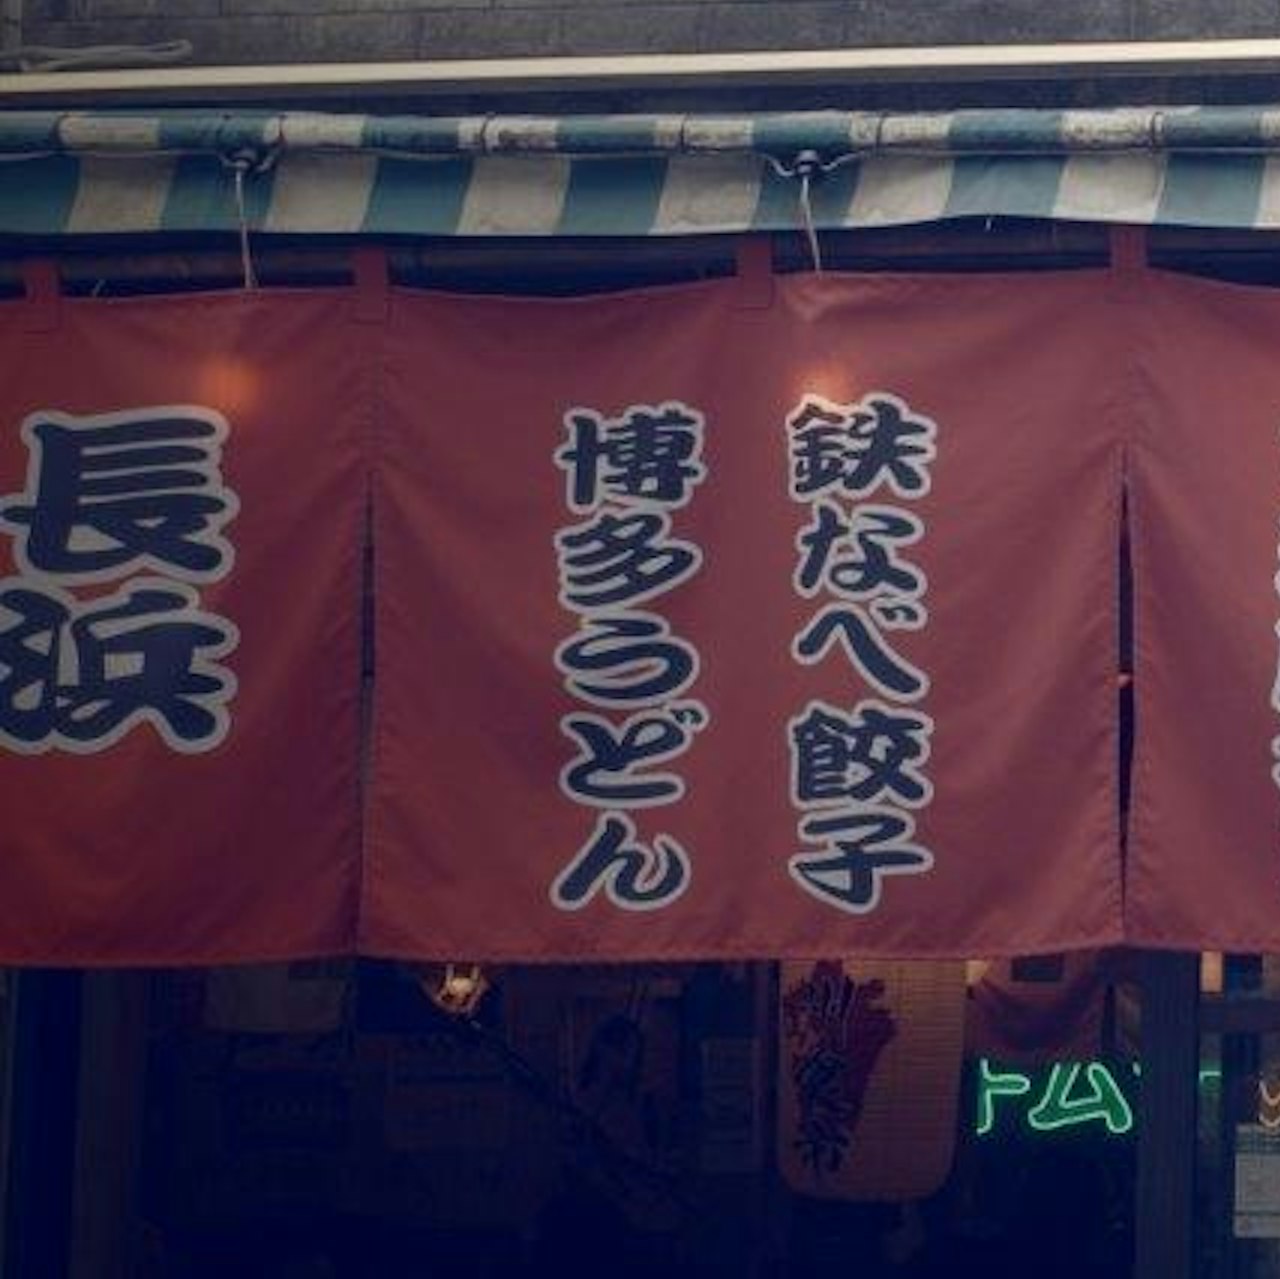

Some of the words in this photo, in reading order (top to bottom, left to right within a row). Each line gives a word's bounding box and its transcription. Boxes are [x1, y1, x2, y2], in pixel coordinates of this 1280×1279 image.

[0, 406, 240, 753] 長浜
[551, 401, 707, 909] 博多うどん
[786, 392, 937, 914] 鉄なべ餃子
